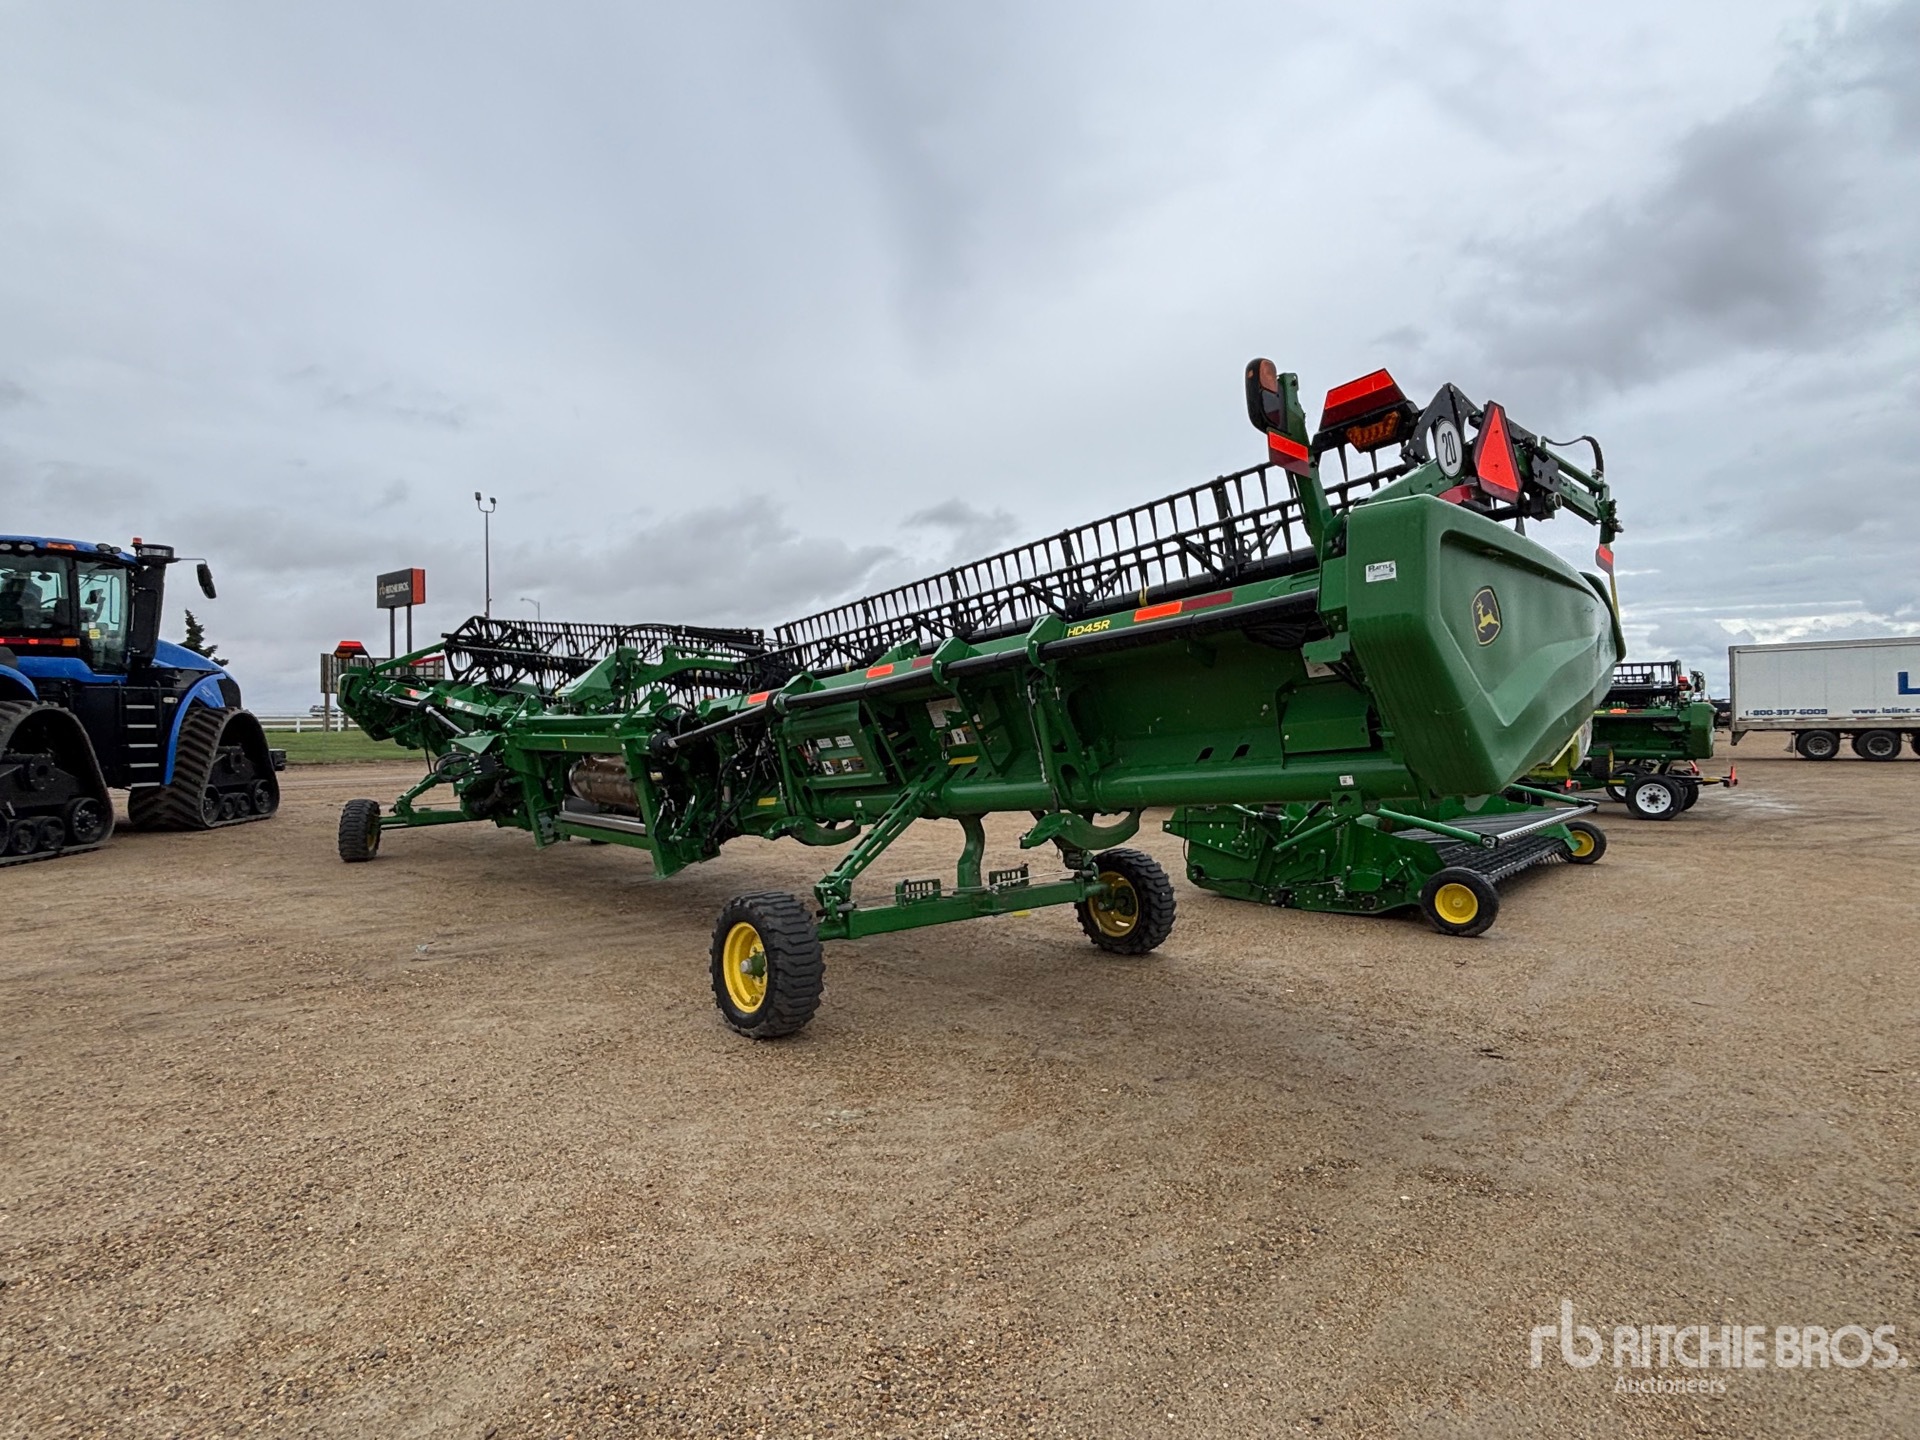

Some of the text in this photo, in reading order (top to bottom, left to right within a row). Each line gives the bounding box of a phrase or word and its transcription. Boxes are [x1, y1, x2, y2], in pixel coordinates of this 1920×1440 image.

[1441, 430, 1457, 467] 20
[1067, 619, 1111, 638] HD45R
[1745, 708, 1828, 716] 1-800-397-6009
